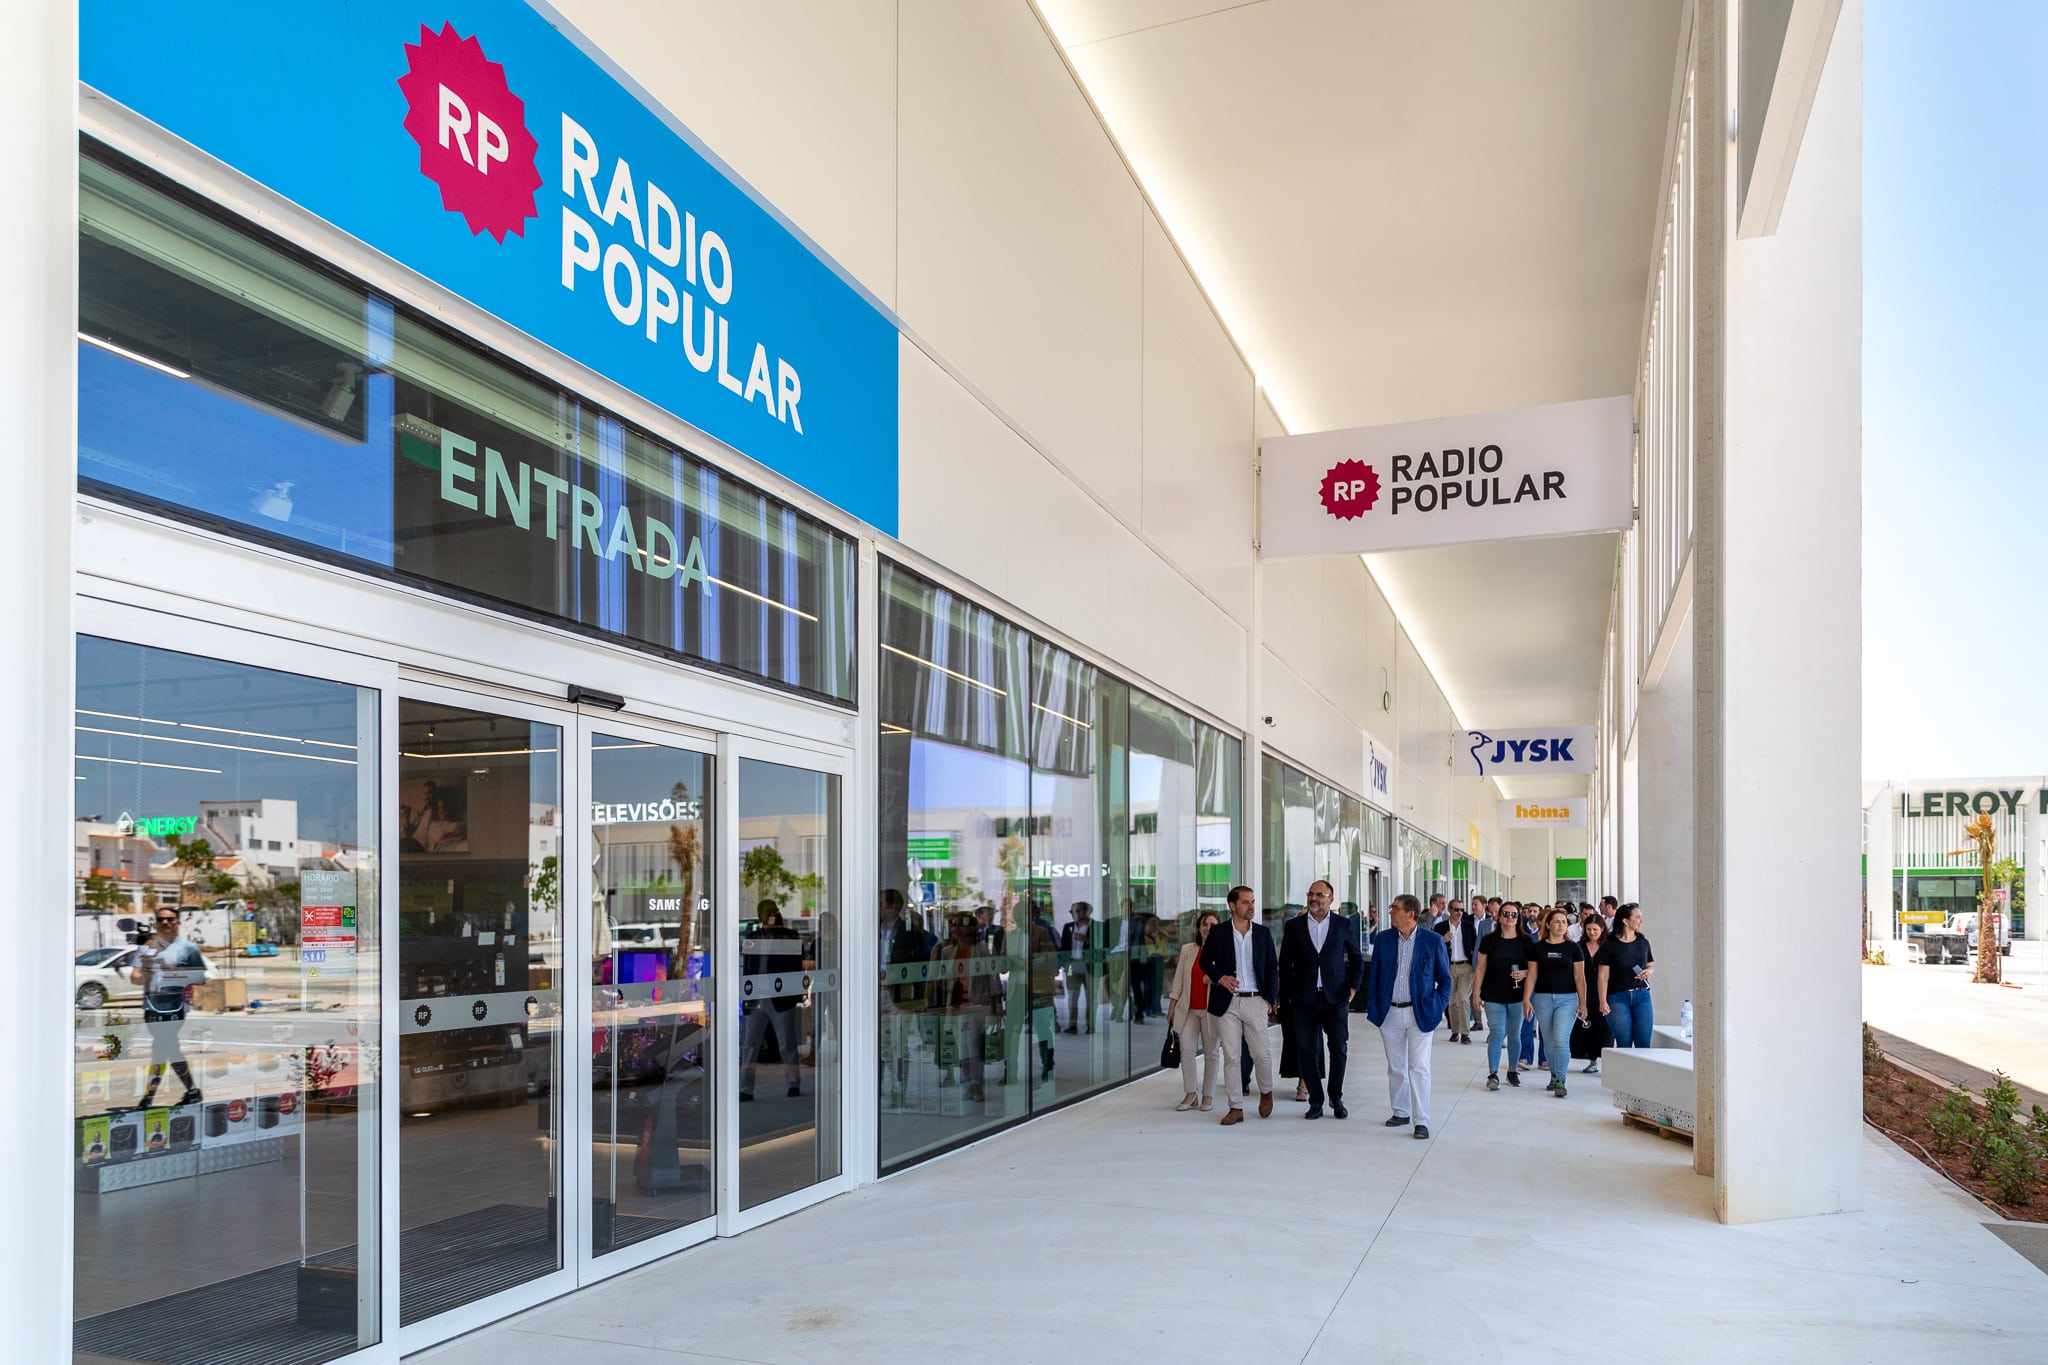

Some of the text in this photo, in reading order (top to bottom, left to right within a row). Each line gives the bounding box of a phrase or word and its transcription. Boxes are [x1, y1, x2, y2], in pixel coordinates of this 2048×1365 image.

[439, 83, 508, 175] RP
[562, 112, 732, 304] RADIO
[562, 205, 803, 435] POPULAR
[1392, 445, 1503, 482] RADIO
[1334, 480, 1366, 501] RP
[1392, 471, 1566, 514] POPULAR
[441, 428, 712, 597] ENTRADA
[1490, 738, 1574, 763] JYSK
[1374, 758, 1388, 794] JYSK
[1902, 790, 2024, 817] LEROY
[135, 816, 198, 835] ENERGY
[418, 1011, 428, 1020] RP
